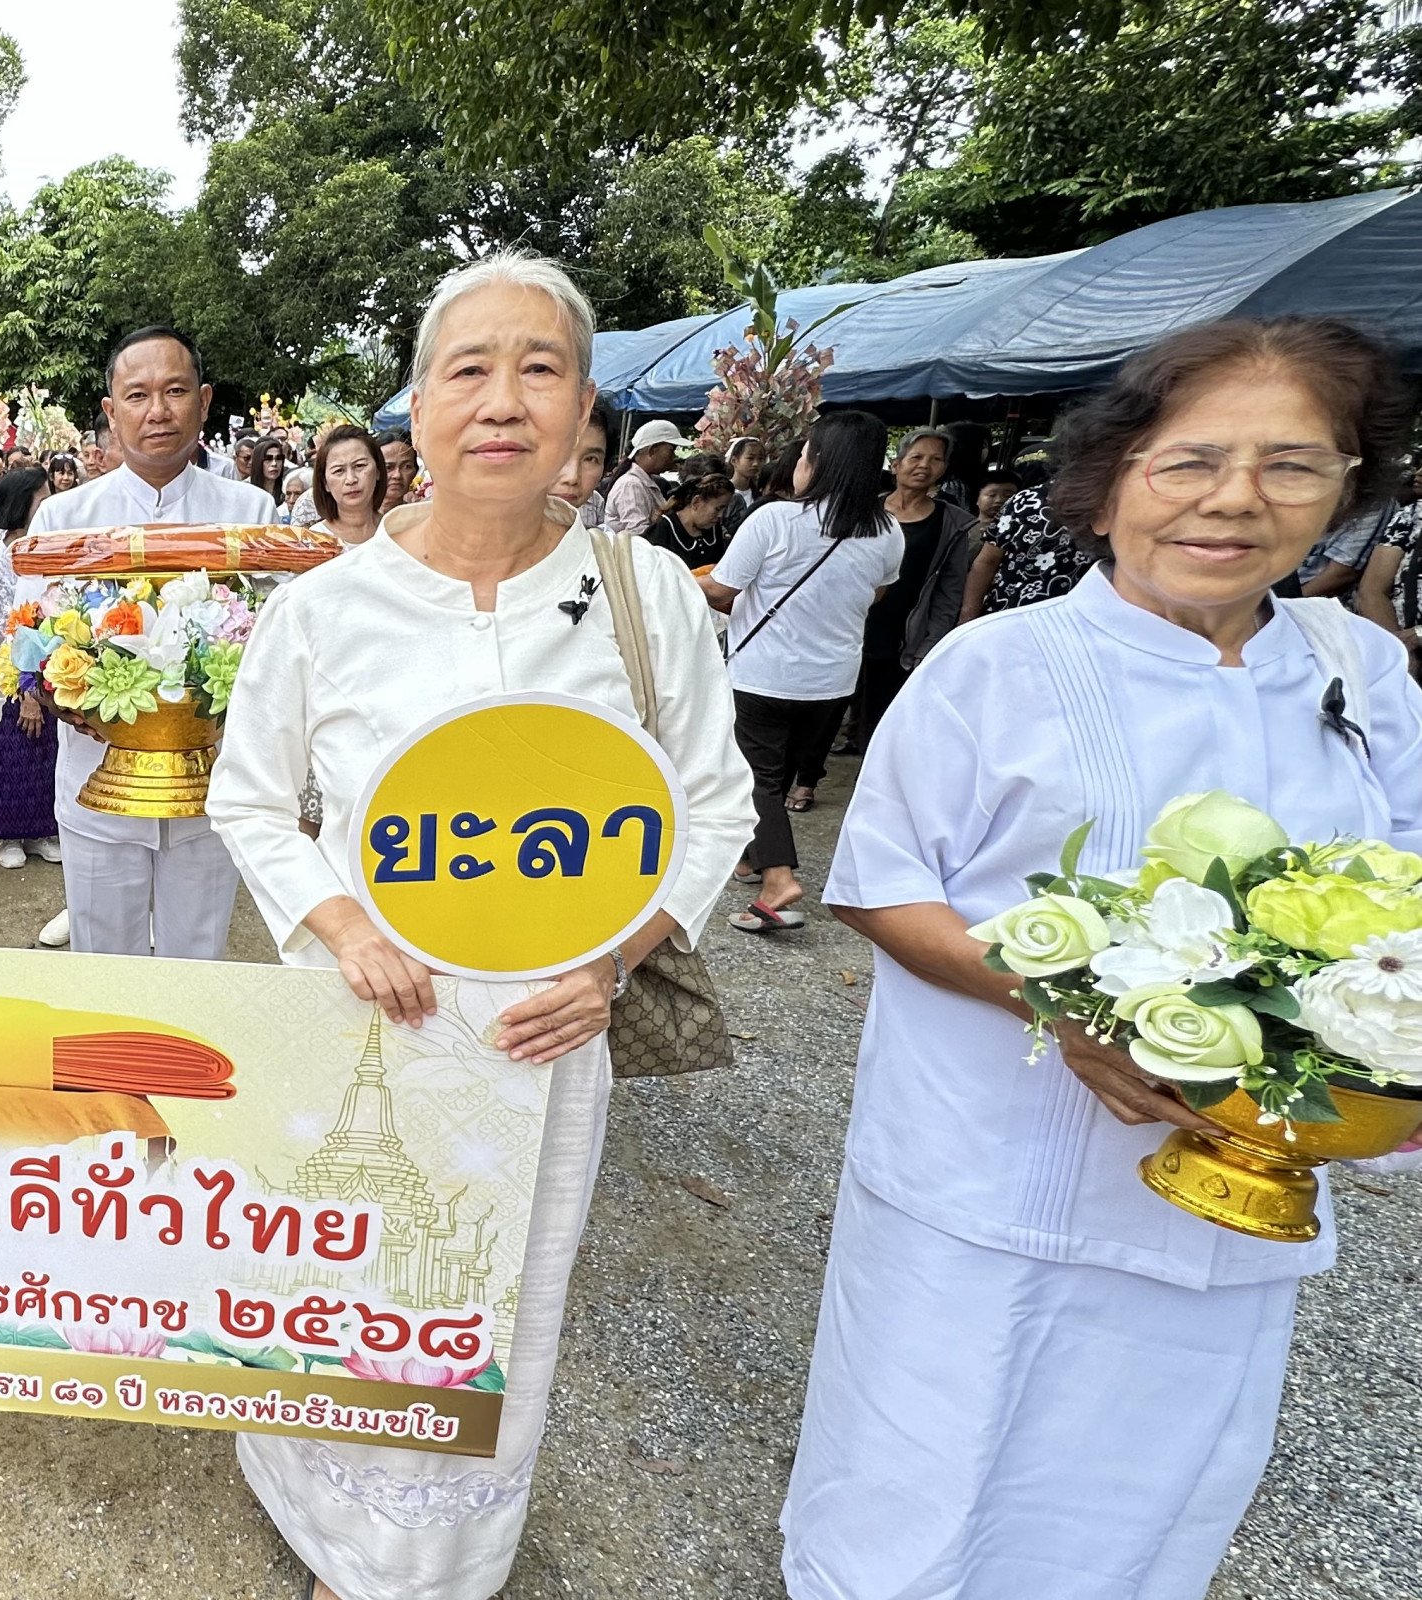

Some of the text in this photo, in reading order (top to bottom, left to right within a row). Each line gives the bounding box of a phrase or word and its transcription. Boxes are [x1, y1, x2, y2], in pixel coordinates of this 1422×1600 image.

[369, 805, 663, 883] ยะลา
[215, 1289, 486, 1360] ๒๕๖๘
[55, 1381, 103, 1404] ๘๑
[120, 1378, 142, 1407] ปี
[159, 1389, 454, 1439] หลวงพ่อธัมมชโย
